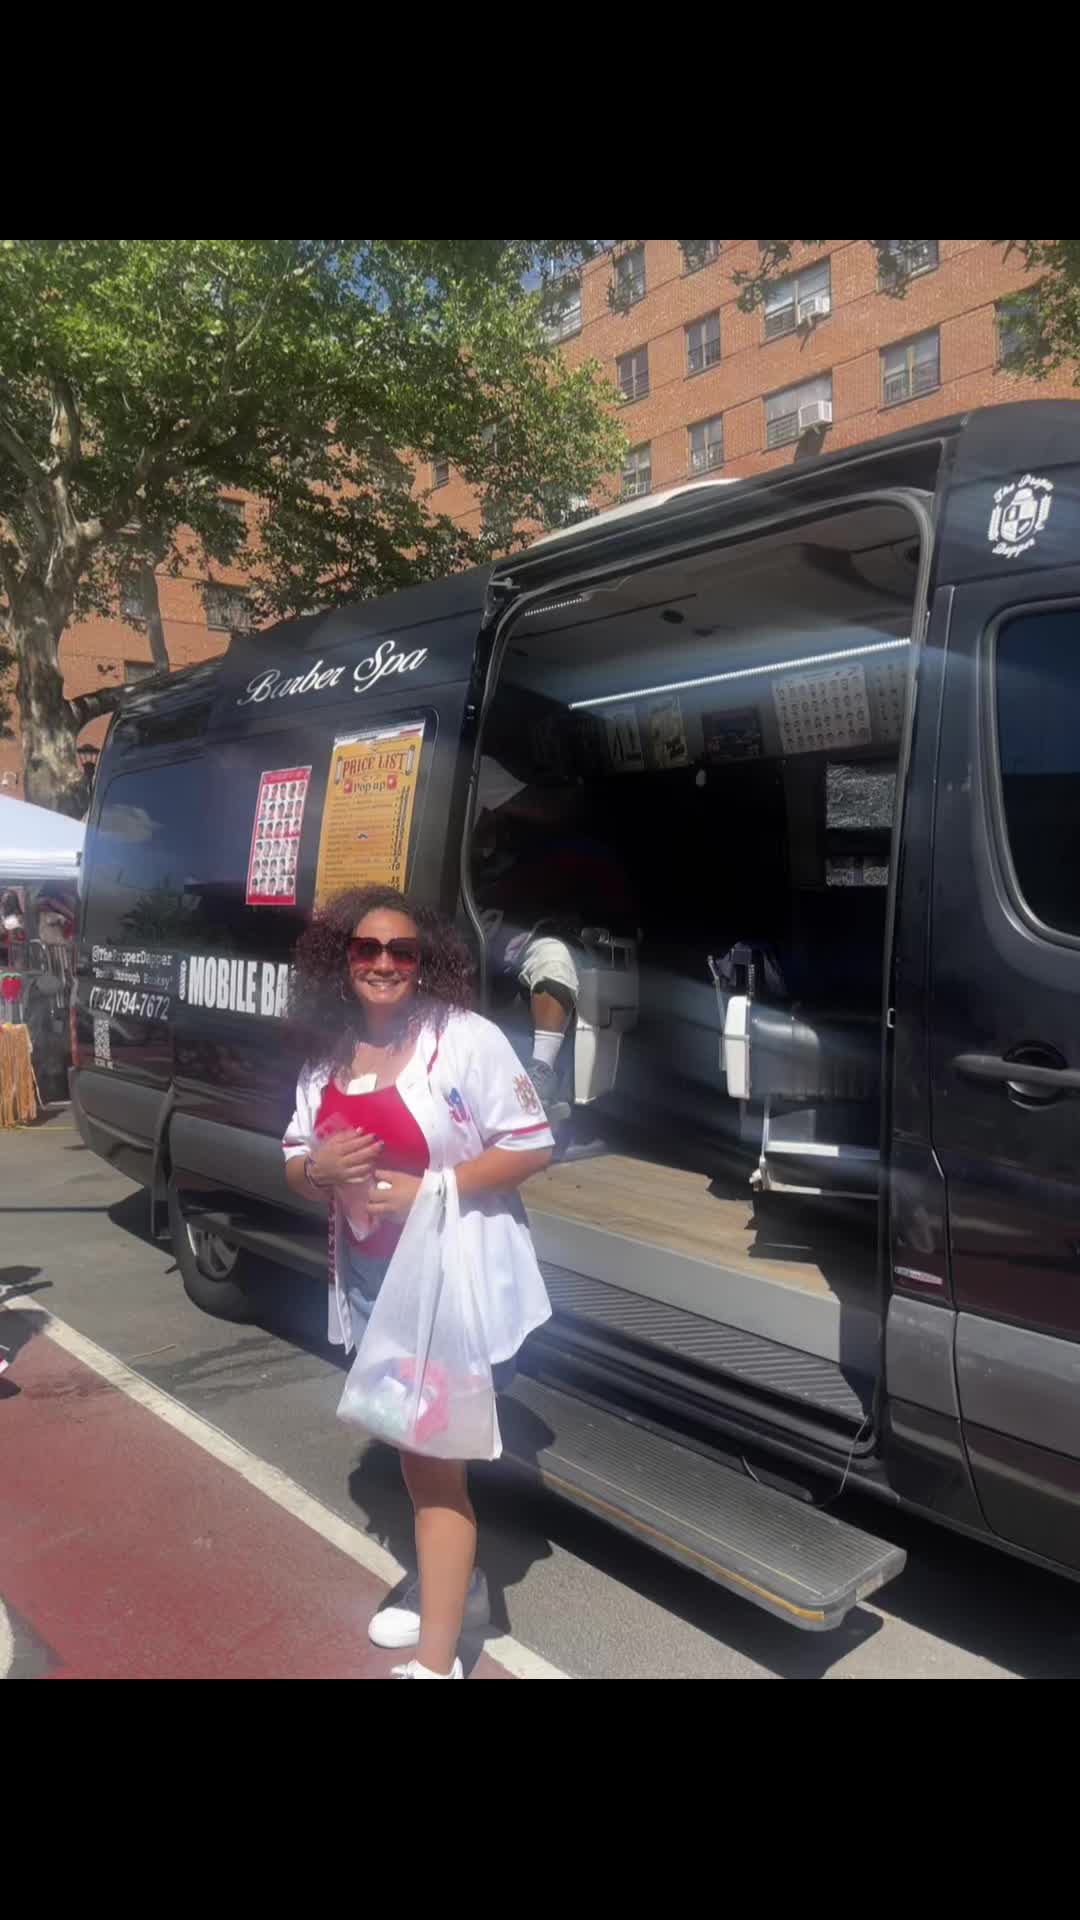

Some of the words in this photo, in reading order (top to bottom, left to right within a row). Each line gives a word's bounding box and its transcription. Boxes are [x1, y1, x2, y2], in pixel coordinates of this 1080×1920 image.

[237, 660, 345, 705] Barber
[353, 640, 428, 693] Spa
[343, 757, 375, 778] PRICE
[378, 752, 407, 771] LIST
[89, 986, 170, 1020] (732)794-7672
[188, 956, 257, 1014] MOBILE
